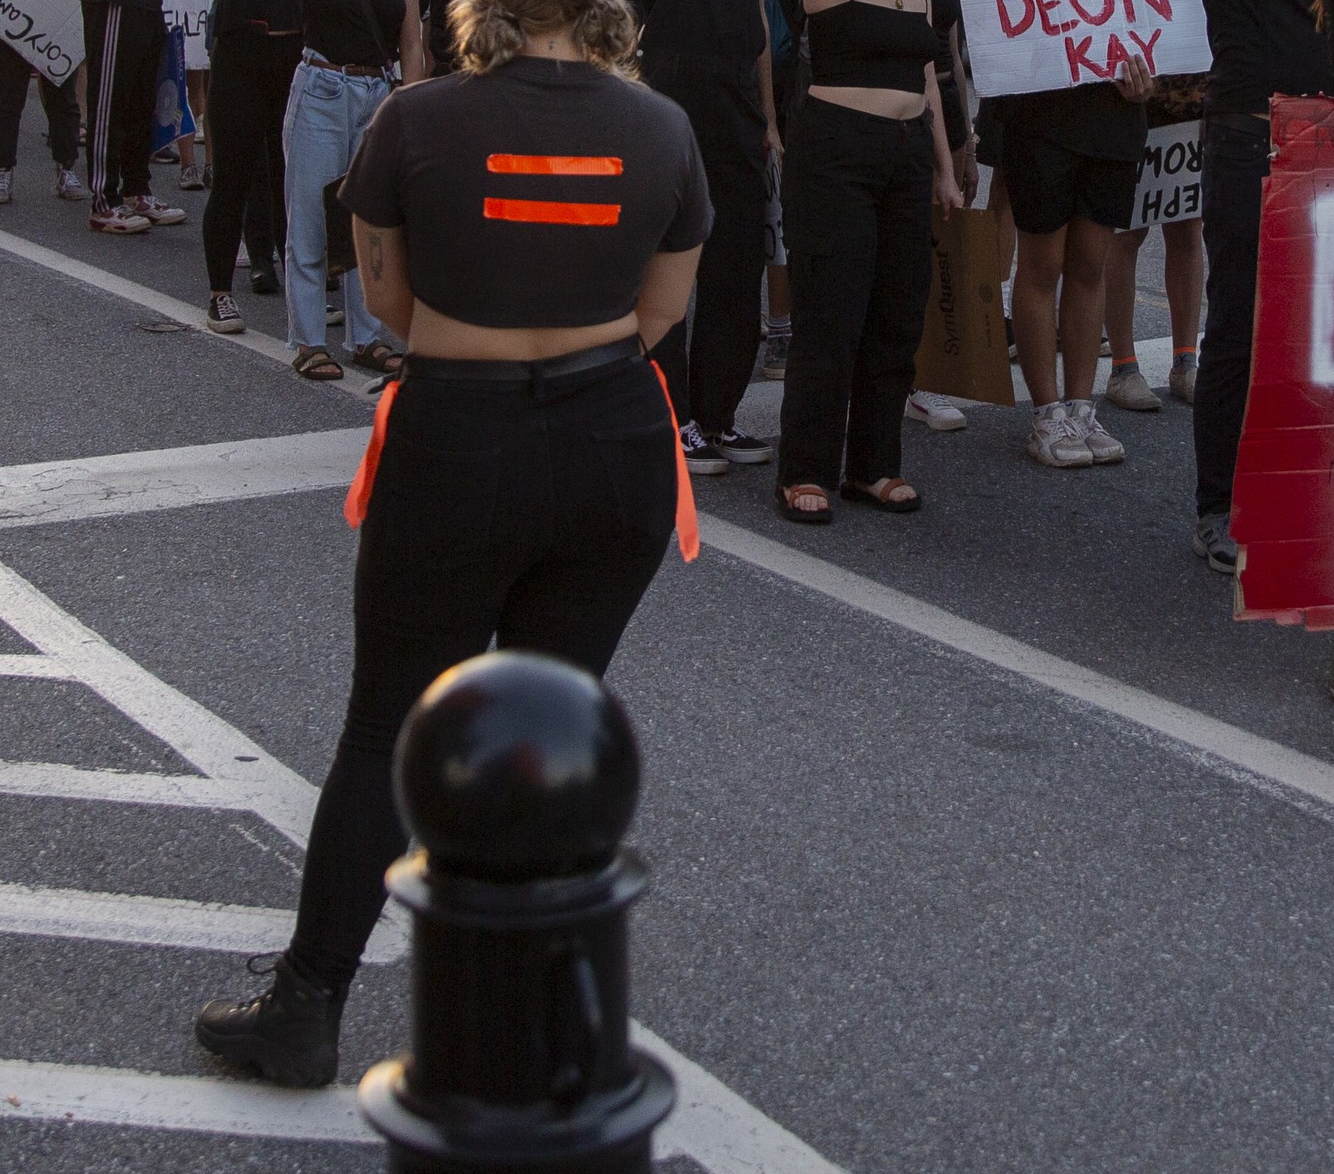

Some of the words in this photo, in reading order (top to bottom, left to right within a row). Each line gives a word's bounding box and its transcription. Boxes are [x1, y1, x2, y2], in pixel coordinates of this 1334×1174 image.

[23, 33, 72, 78] Cory
[1065, 28, 1163, 85] KAY
[1141, 182, 1199, 224] EPH
[936, 250, 960, 356] SymQuest
